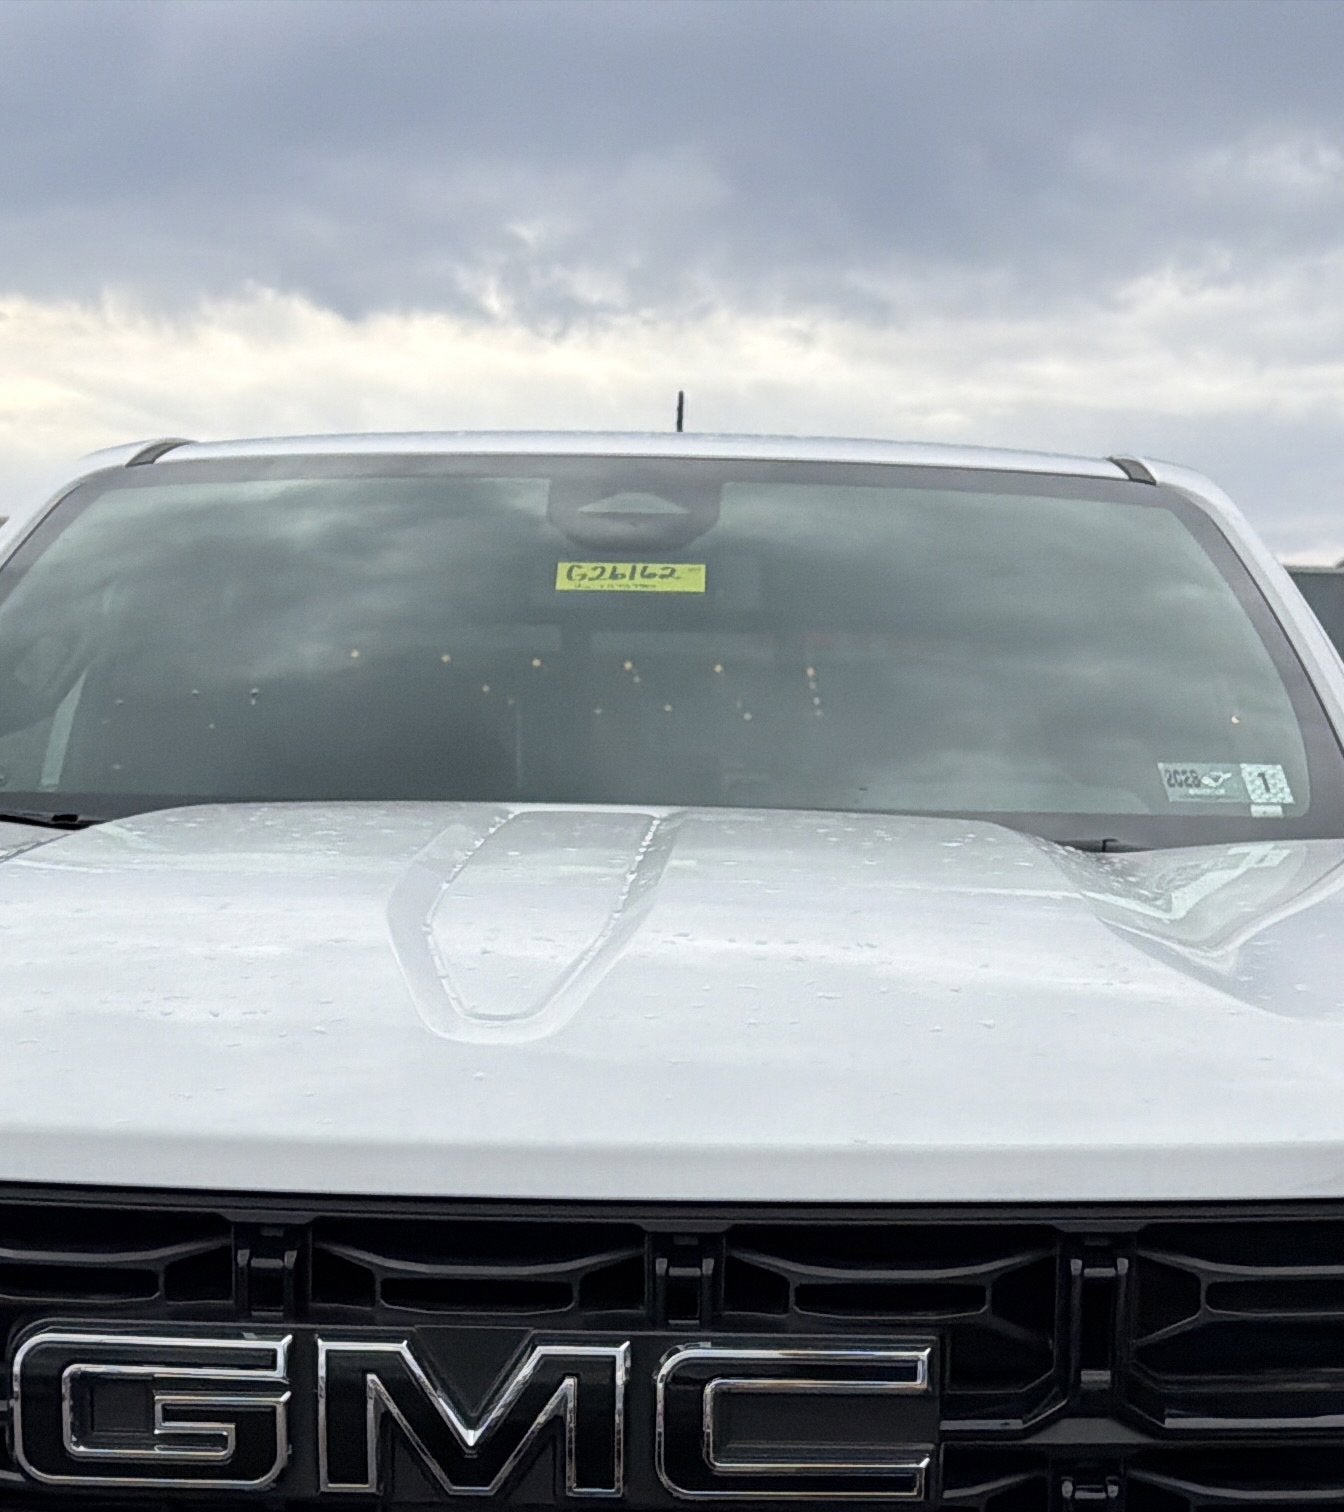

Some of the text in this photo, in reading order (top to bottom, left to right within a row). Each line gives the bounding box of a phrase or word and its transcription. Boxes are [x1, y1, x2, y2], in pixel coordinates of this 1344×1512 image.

[566, 564, 681, 582] G26162
[1257, 772, 1271, 793] 1
[11, 1330, 933, 1500] GMC
